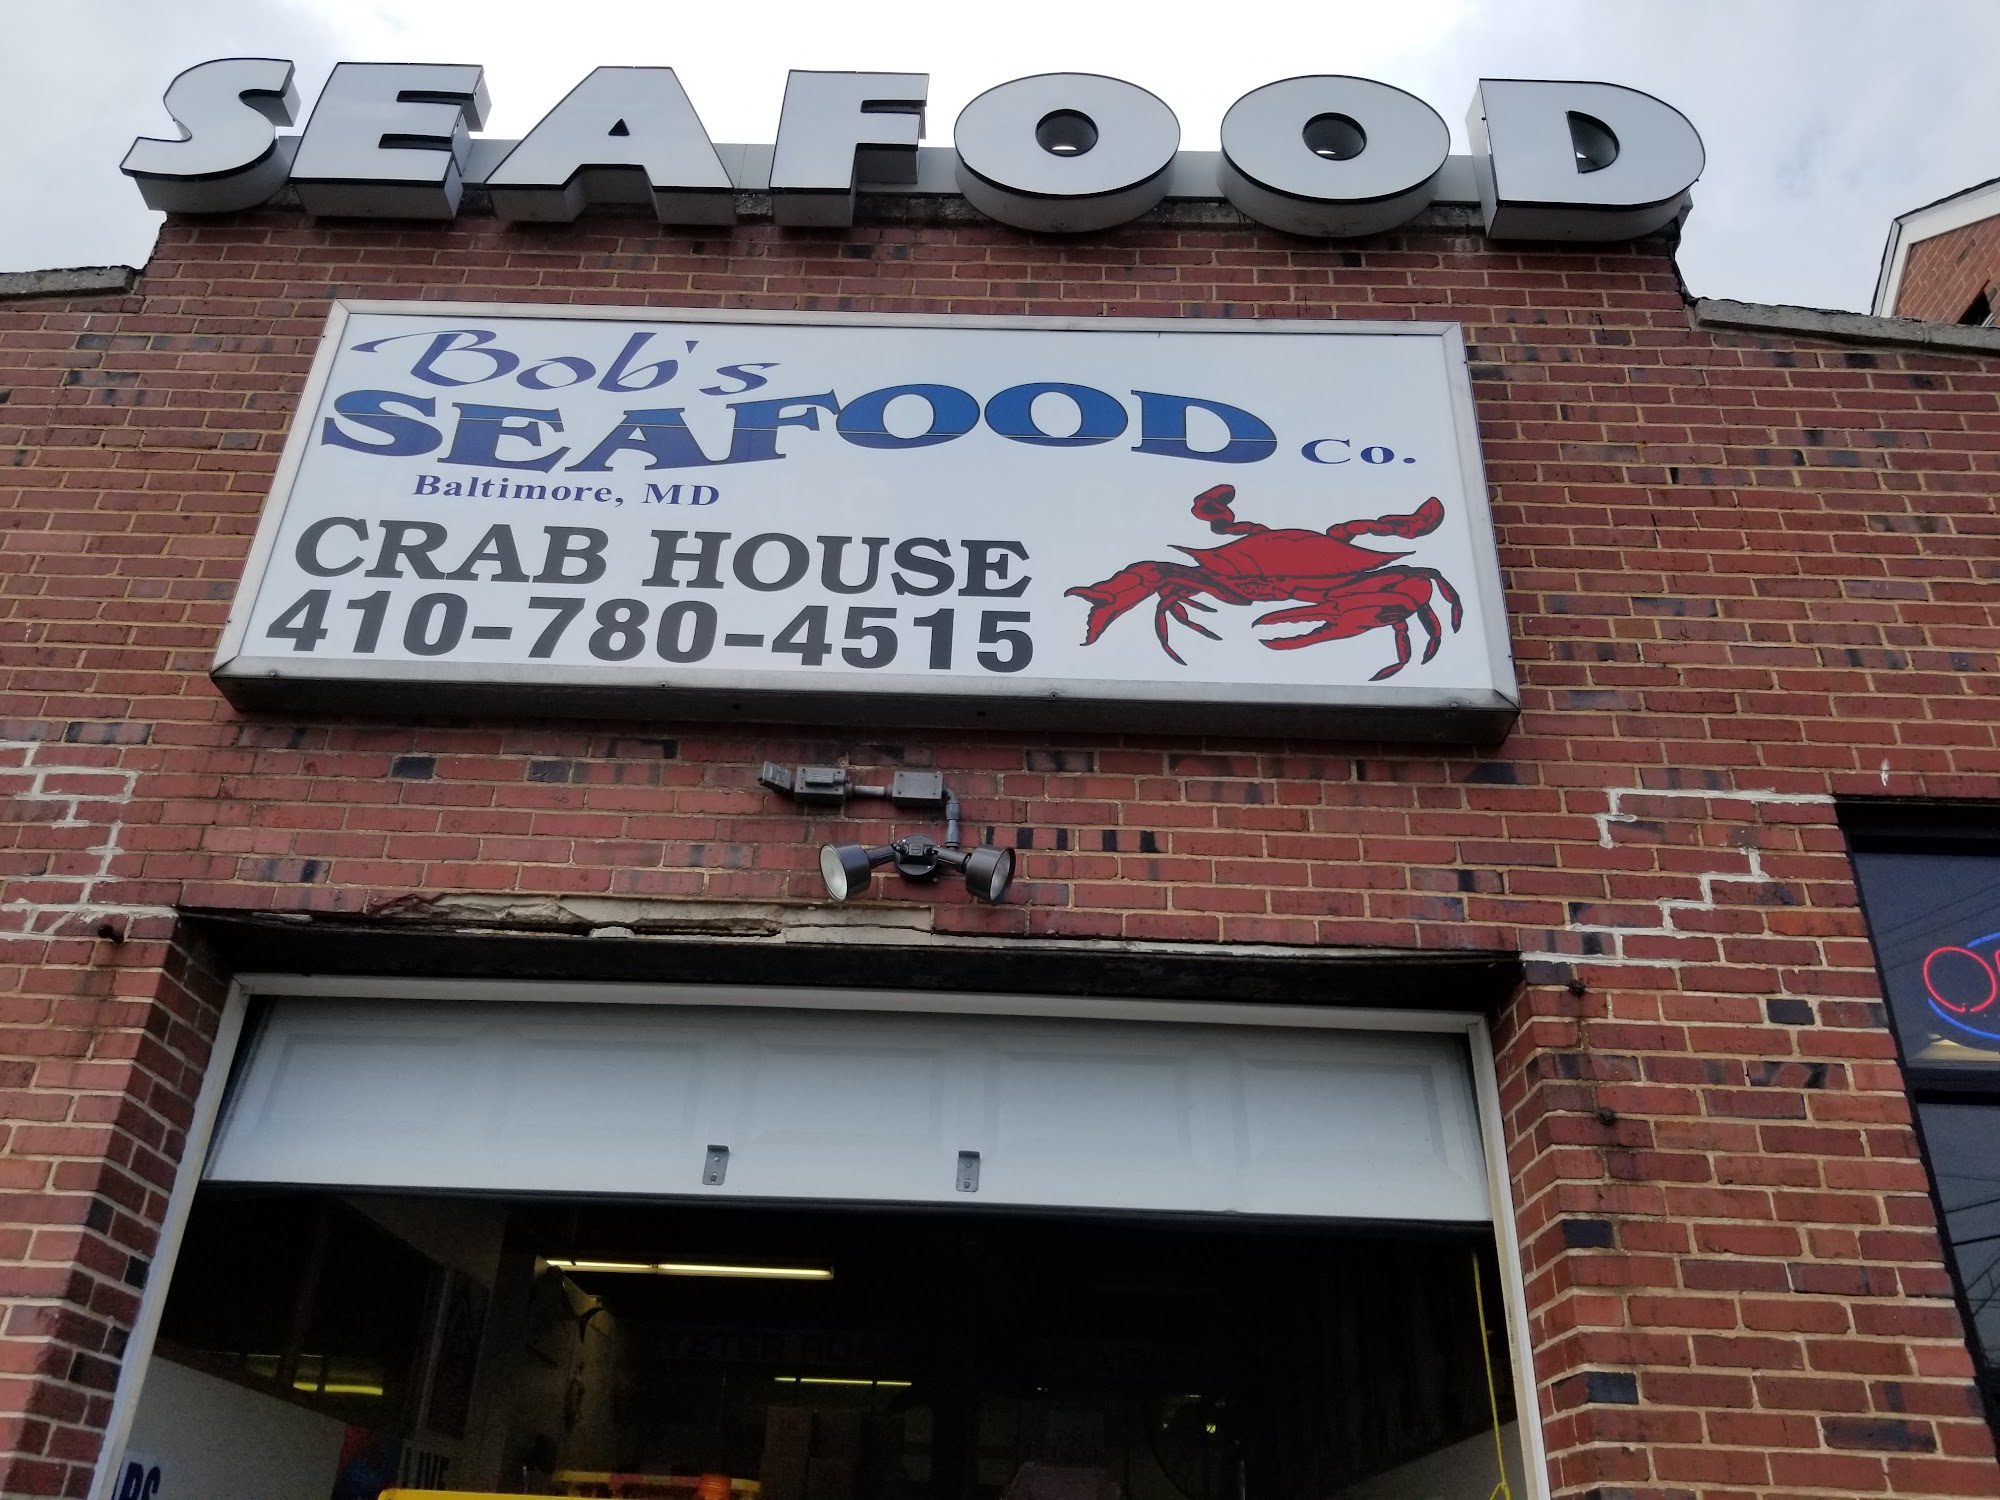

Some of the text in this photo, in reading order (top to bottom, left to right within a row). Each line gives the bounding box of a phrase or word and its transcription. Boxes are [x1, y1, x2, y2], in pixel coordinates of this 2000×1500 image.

[119, 57, 1706, 214] SEAFOOD
[350, 330, 781, 396] Bob's
[320, 381, 1417, 474] SEAFOOD Co.
[413, 474, 624, 508] Baltimore,
[641, 483, 720, 506] MD
[295, 516, 1033, 598] CRAB HOUSE
[265, 589, 1034, 673] 410-780-4515
